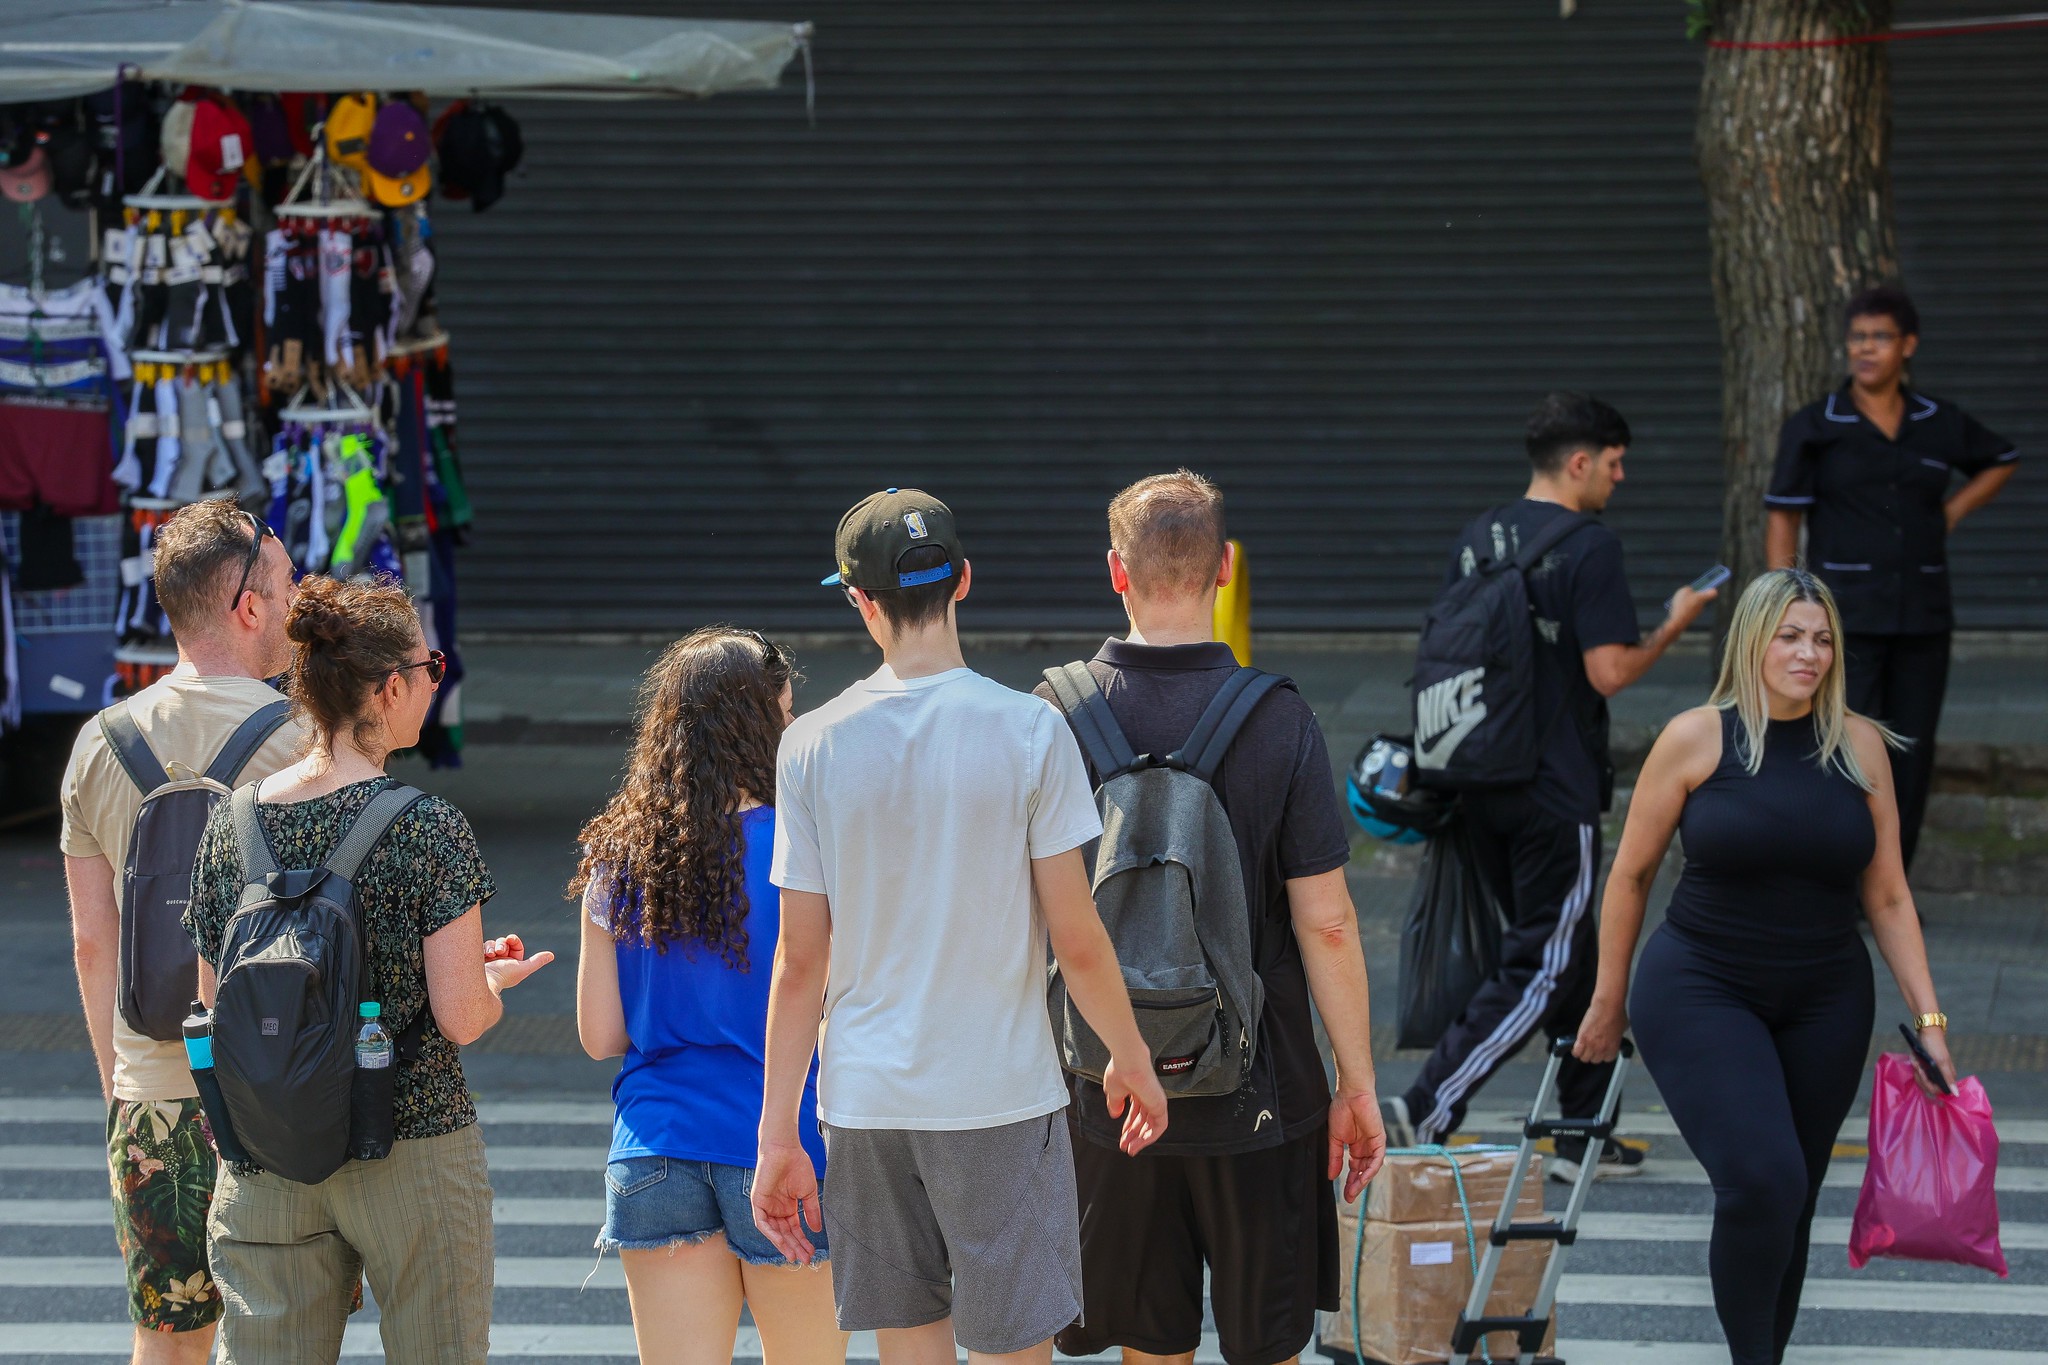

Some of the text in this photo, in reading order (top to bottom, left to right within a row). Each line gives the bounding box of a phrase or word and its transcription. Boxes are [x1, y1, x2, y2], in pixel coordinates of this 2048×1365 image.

[1417, 666, 1487, 744] NIKE
[263, 1022, 276, 1031] MEC
[1162, 1059, 1195, 1070] EASTPAK
